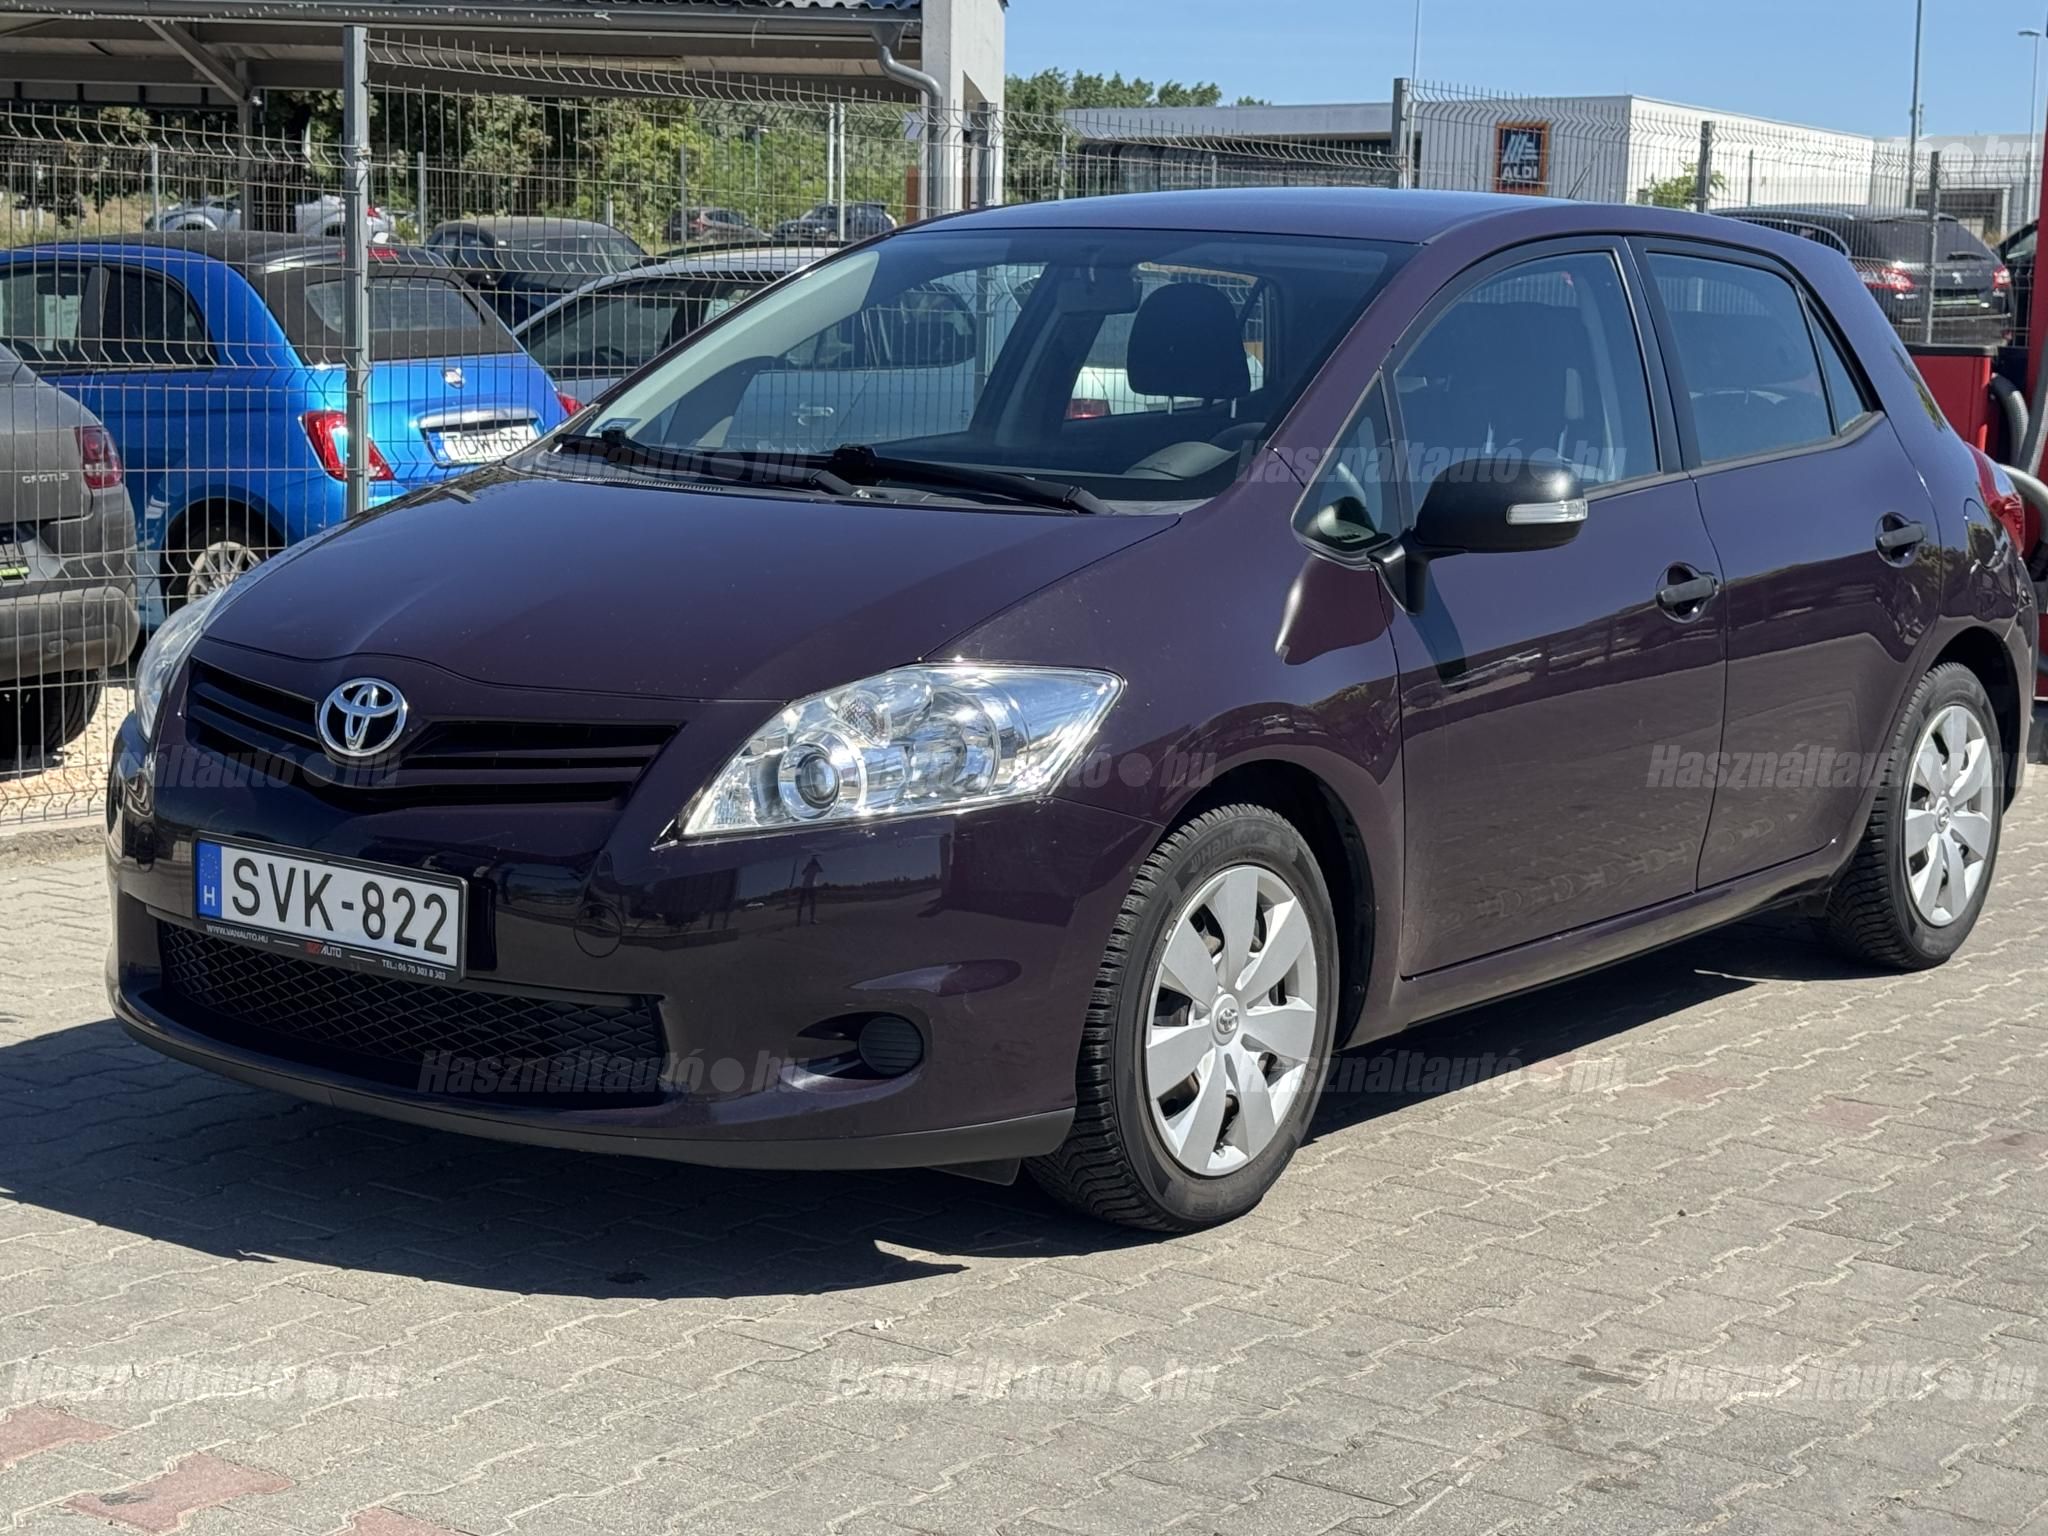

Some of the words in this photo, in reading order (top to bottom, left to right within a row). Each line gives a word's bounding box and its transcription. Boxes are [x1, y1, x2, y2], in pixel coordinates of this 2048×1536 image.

[1502, 165, 1538, 179] ALDI
[203, 884, 215, 907] H
[231, 857, 448, 955] SVK-822
